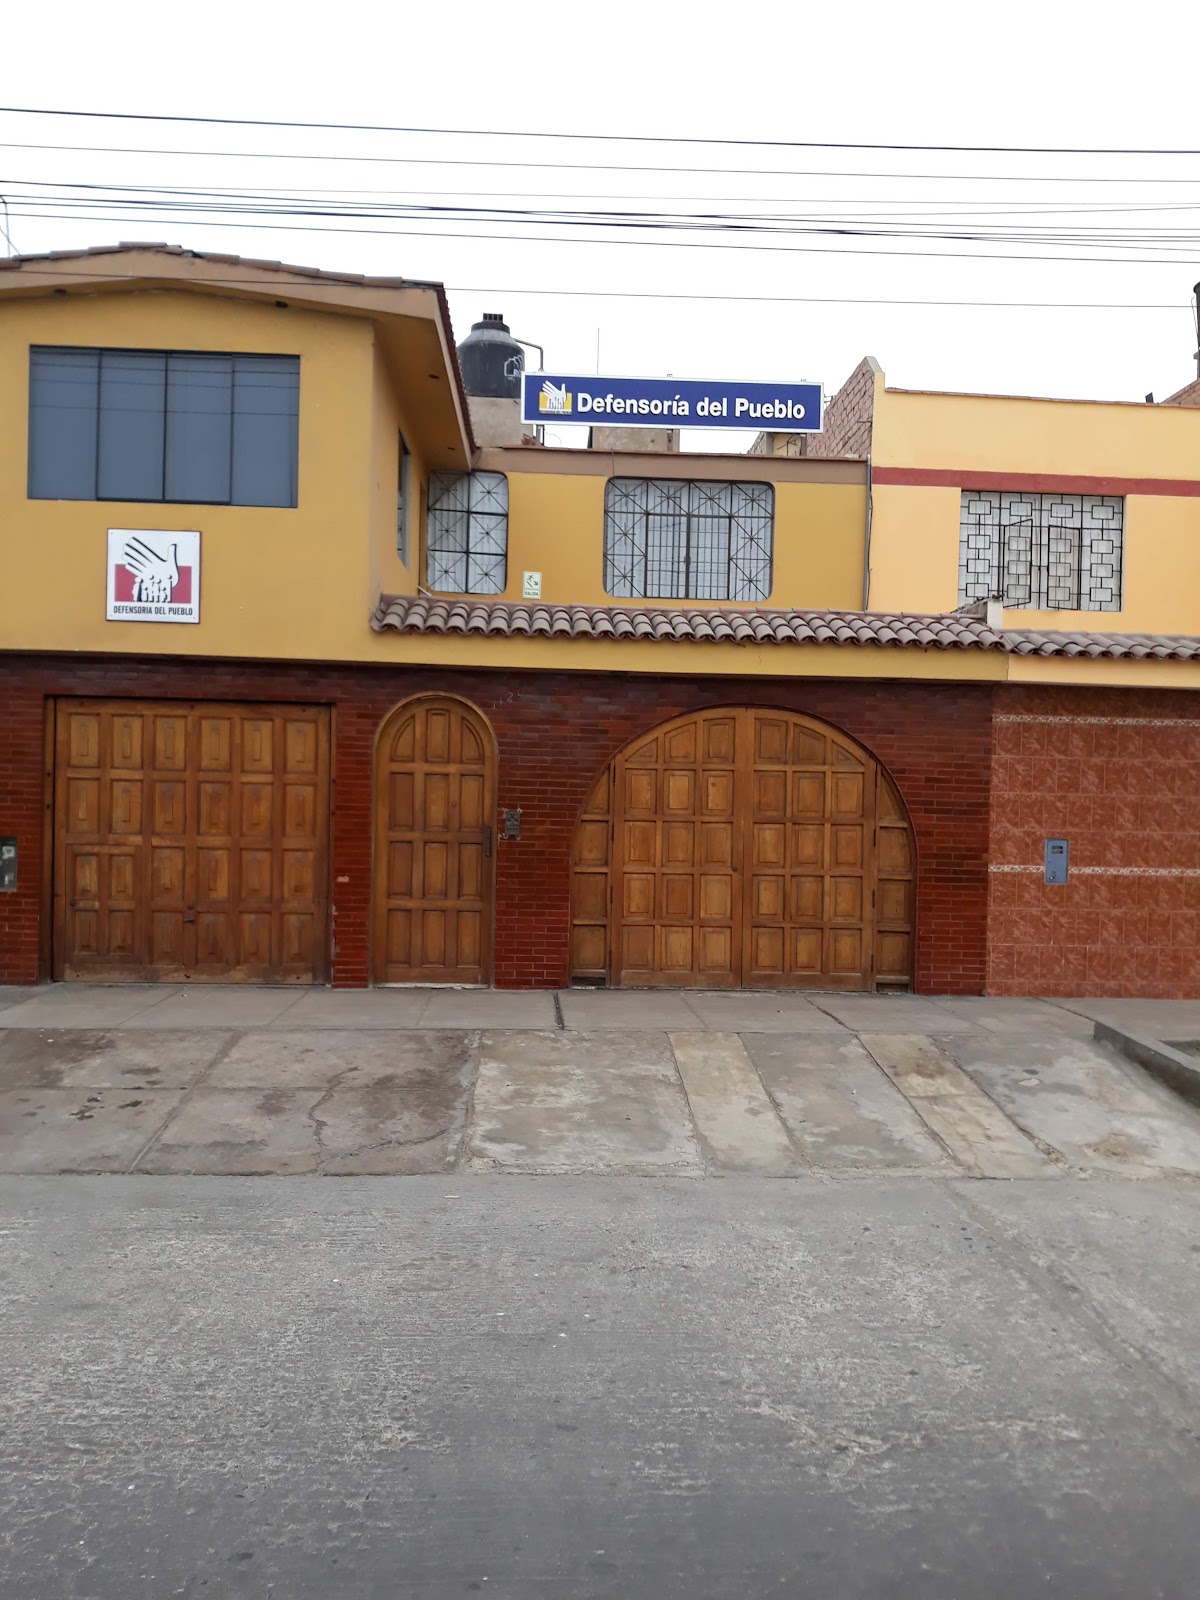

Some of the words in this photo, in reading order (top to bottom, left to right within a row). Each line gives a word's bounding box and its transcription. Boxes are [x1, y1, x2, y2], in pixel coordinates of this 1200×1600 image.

[577, 392, 690, 416] Defensoría
[696, 397, 728, 417] del
[735, 398, 806, 419] Pueblo
[113, 605, 153, 615] DEFENSORIA
[154, 606, 167, 615] DEL
[168, 607, 193, 616] PUEBLO
